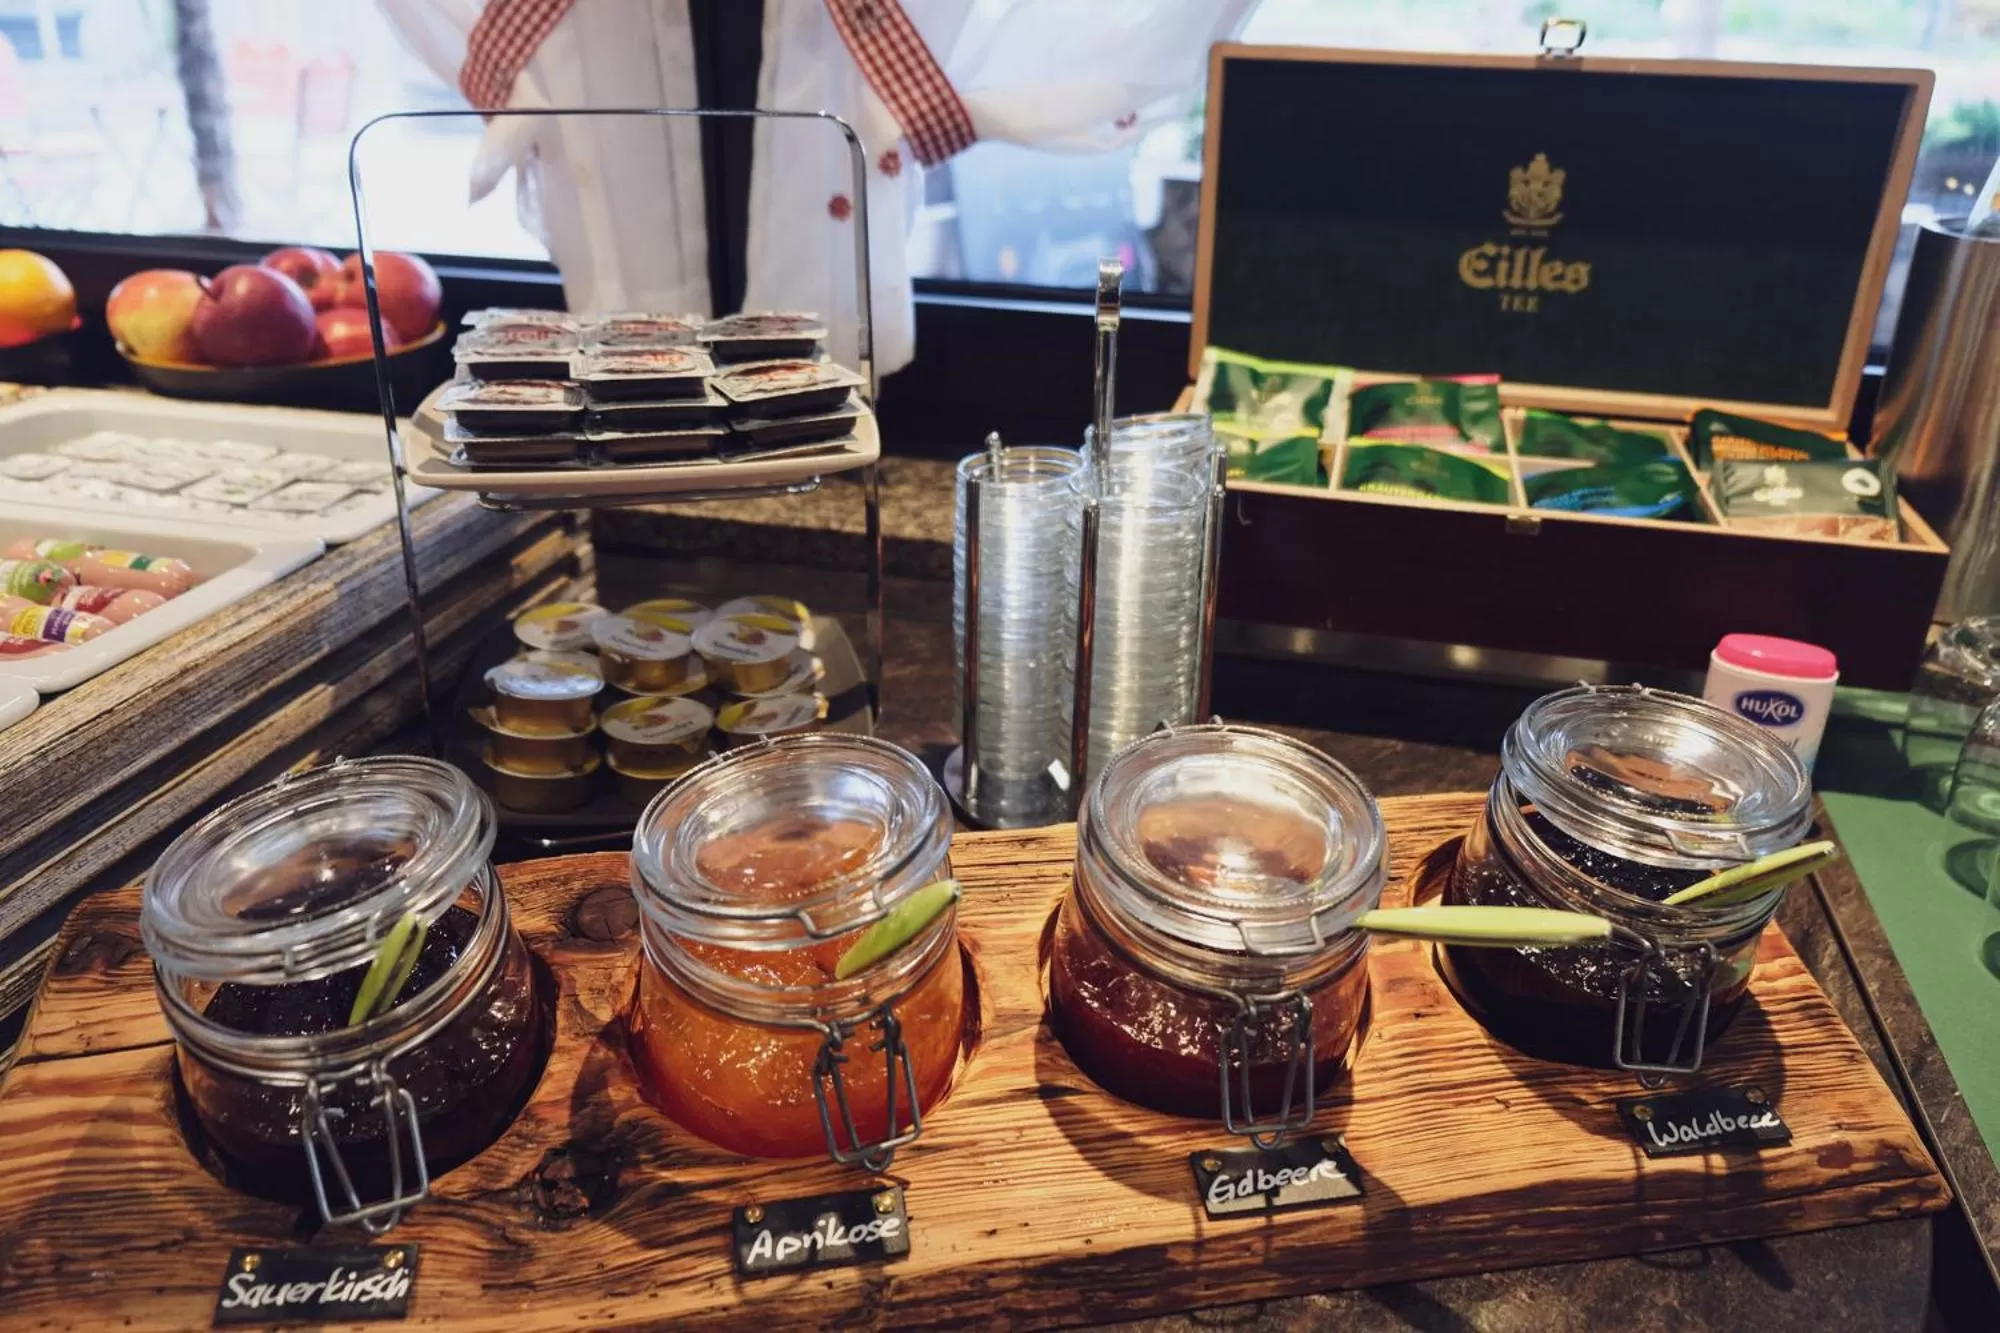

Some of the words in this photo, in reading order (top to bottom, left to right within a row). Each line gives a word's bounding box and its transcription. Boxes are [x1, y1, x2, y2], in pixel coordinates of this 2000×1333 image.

[1458, 241, 1592, 293] Eilles
[1740, 696, 1799, 722] HUXOL
[746, 1216, 901, 1265] Aprikose
[221, 1266, 410, 1308] Sauerkirsch
